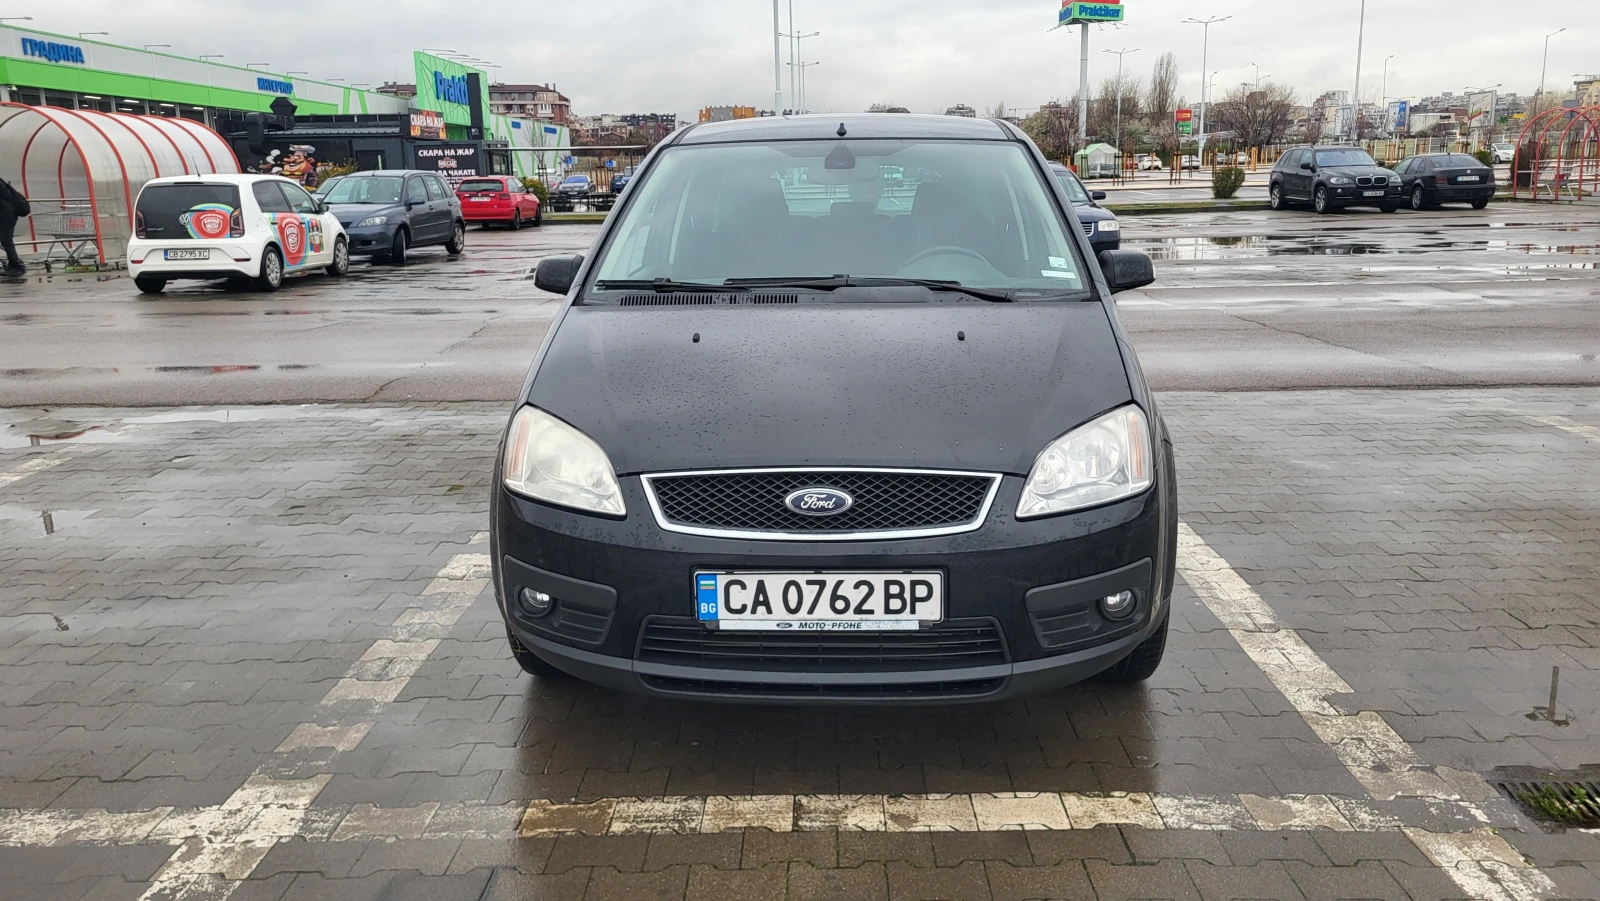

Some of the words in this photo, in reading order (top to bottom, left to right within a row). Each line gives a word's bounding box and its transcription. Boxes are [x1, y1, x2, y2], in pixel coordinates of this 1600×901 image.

[1079, 4, 1121, 18] Praktiker
[21, 37, 85, 64] ГРАДИНА
[257, 77, 294, 95] ИНТЕРИОР
[418, 149, 444, 157] СКАРА
[444, 148, 456, 157] НА
[456, 148, 475, 156] ЖАР
[168, 250, 179, 258] CB
[179, 250, 197, 258] 2795
[198, 250, 208, 258] XC
[800, 493, 837, 510] Ford
[723, 579, 774, 615] CA
[782, 579, 876, 615] 0762
[883, 579, 934, 615] BP
[700, 602, 716, 614] BG
